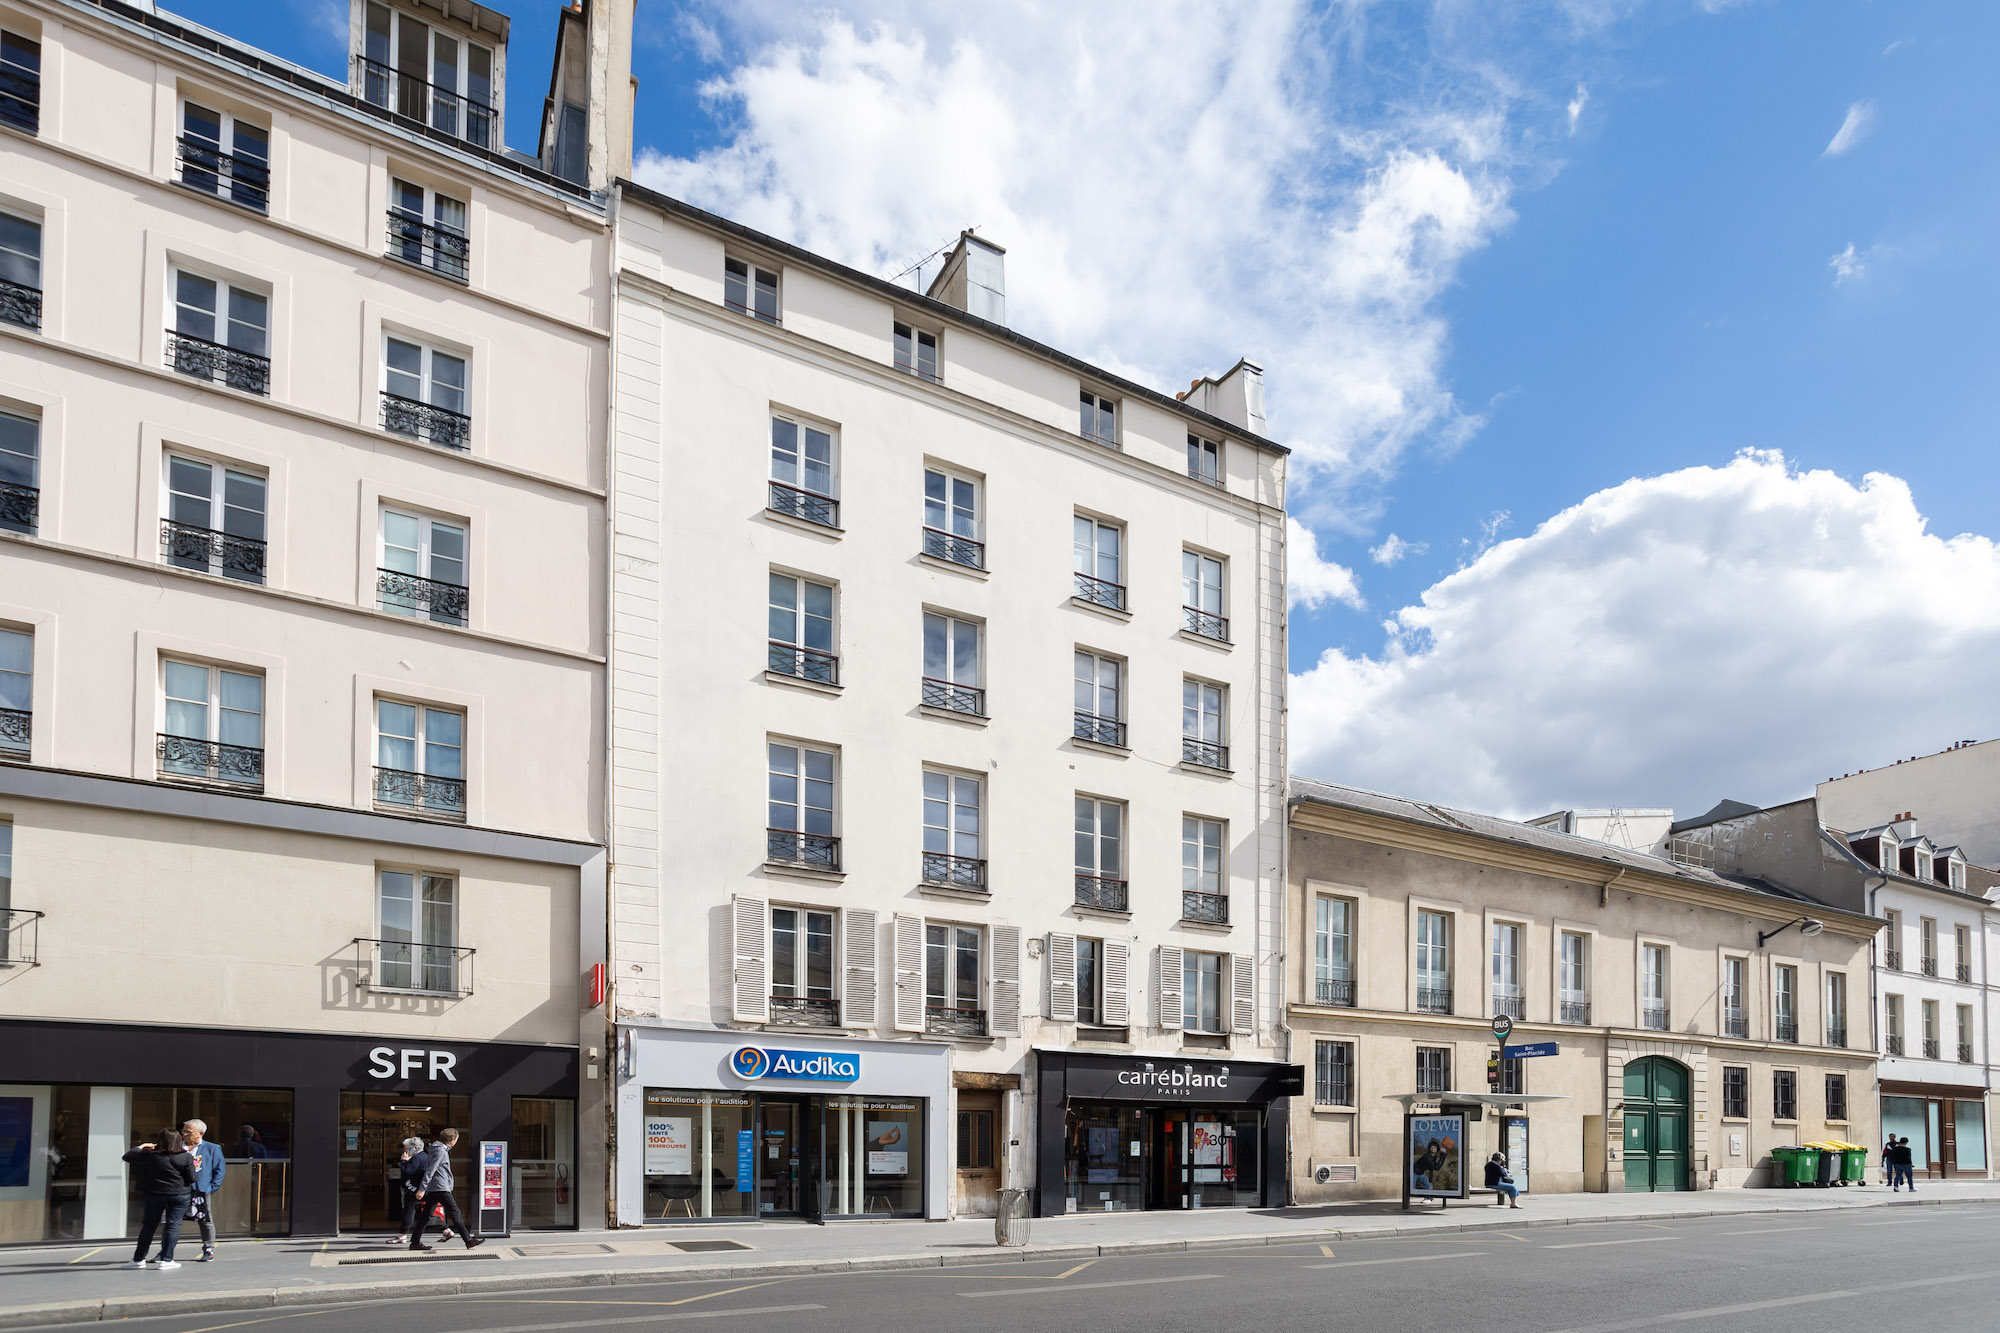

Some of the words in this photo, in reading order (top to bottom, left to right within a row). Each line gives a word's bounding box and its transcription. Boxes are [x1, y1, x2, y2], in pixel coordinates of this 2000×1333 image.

[1494, 1020, 1508, 1028] BUS
[1514, 1049, 1545, 1057] Saint-Placide
[368, 1046, 457, 1081] SFR
[773, 1054, 855, 1076] Audika
[1157, 1088, 1190, 1096] PARIS
[648, 1095, 659, 1103] les
[661, 1096, 695, 1104] solutions
[648, 1123, 675, 1131] 100%
[1414, 1120, 1460, 1132] LOEWE
[648, 1136, 675, 1144] 100%
